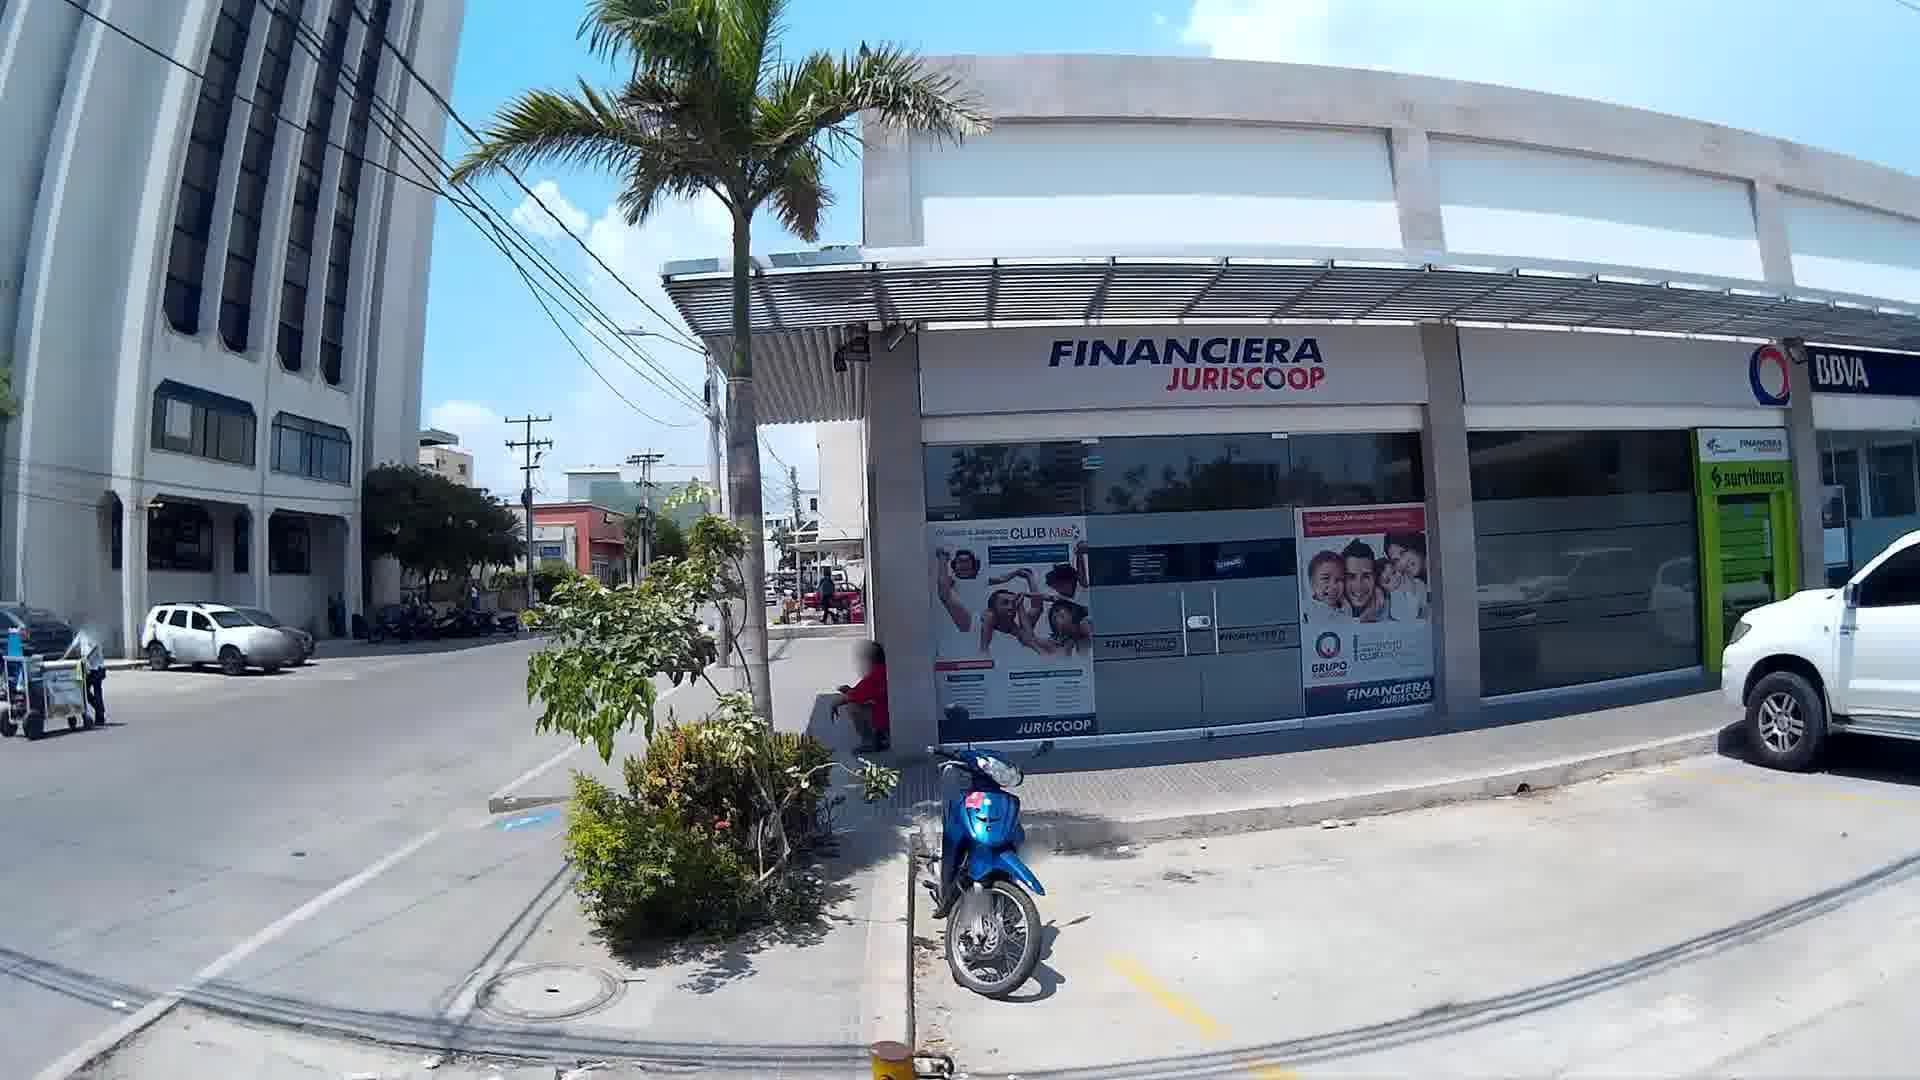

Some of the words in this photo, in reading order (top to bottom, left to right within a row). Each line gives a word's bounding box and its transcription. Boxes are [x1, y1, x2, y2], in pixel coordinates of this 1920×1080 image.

[1049, 337, 1324, 367] FINANCIERA
[1166, 367, 1326, 391] JURISCOOP
[1815, 354, 1869, 388] BBVA
[1010, 527, 1046, 540] CLUB
[1311, 661, 1348, 674] GRUPO
[1346, 680, 1432, 701] FINANCIERA
[1016, 719, 1092, 735] JURISCOOP
